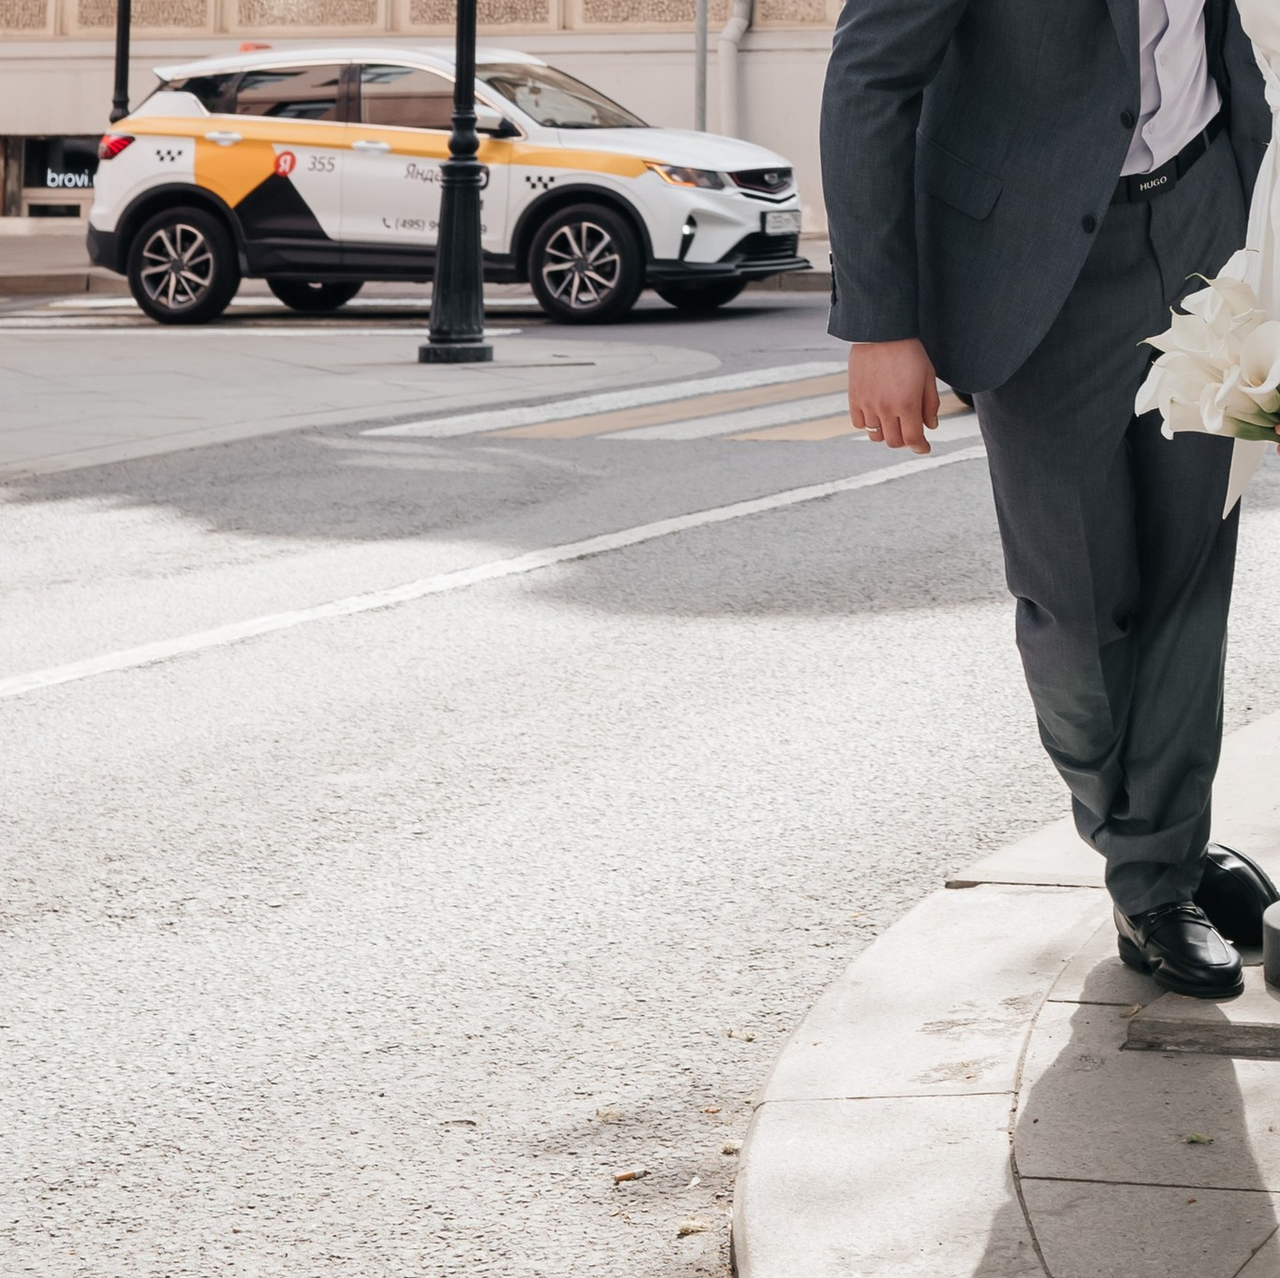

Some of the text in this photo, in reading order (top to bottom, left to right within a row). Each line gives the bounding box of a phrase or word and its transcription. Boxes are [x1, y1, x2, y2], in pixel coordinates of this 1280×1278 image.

[279, 154, 291, 173] Я
[308, 155, 335, 172] 355
[405, 163, 443, 183] Янде
[47, 168, 96, 187] brovi.
[1140, 176, 1167, 191] HUGO
